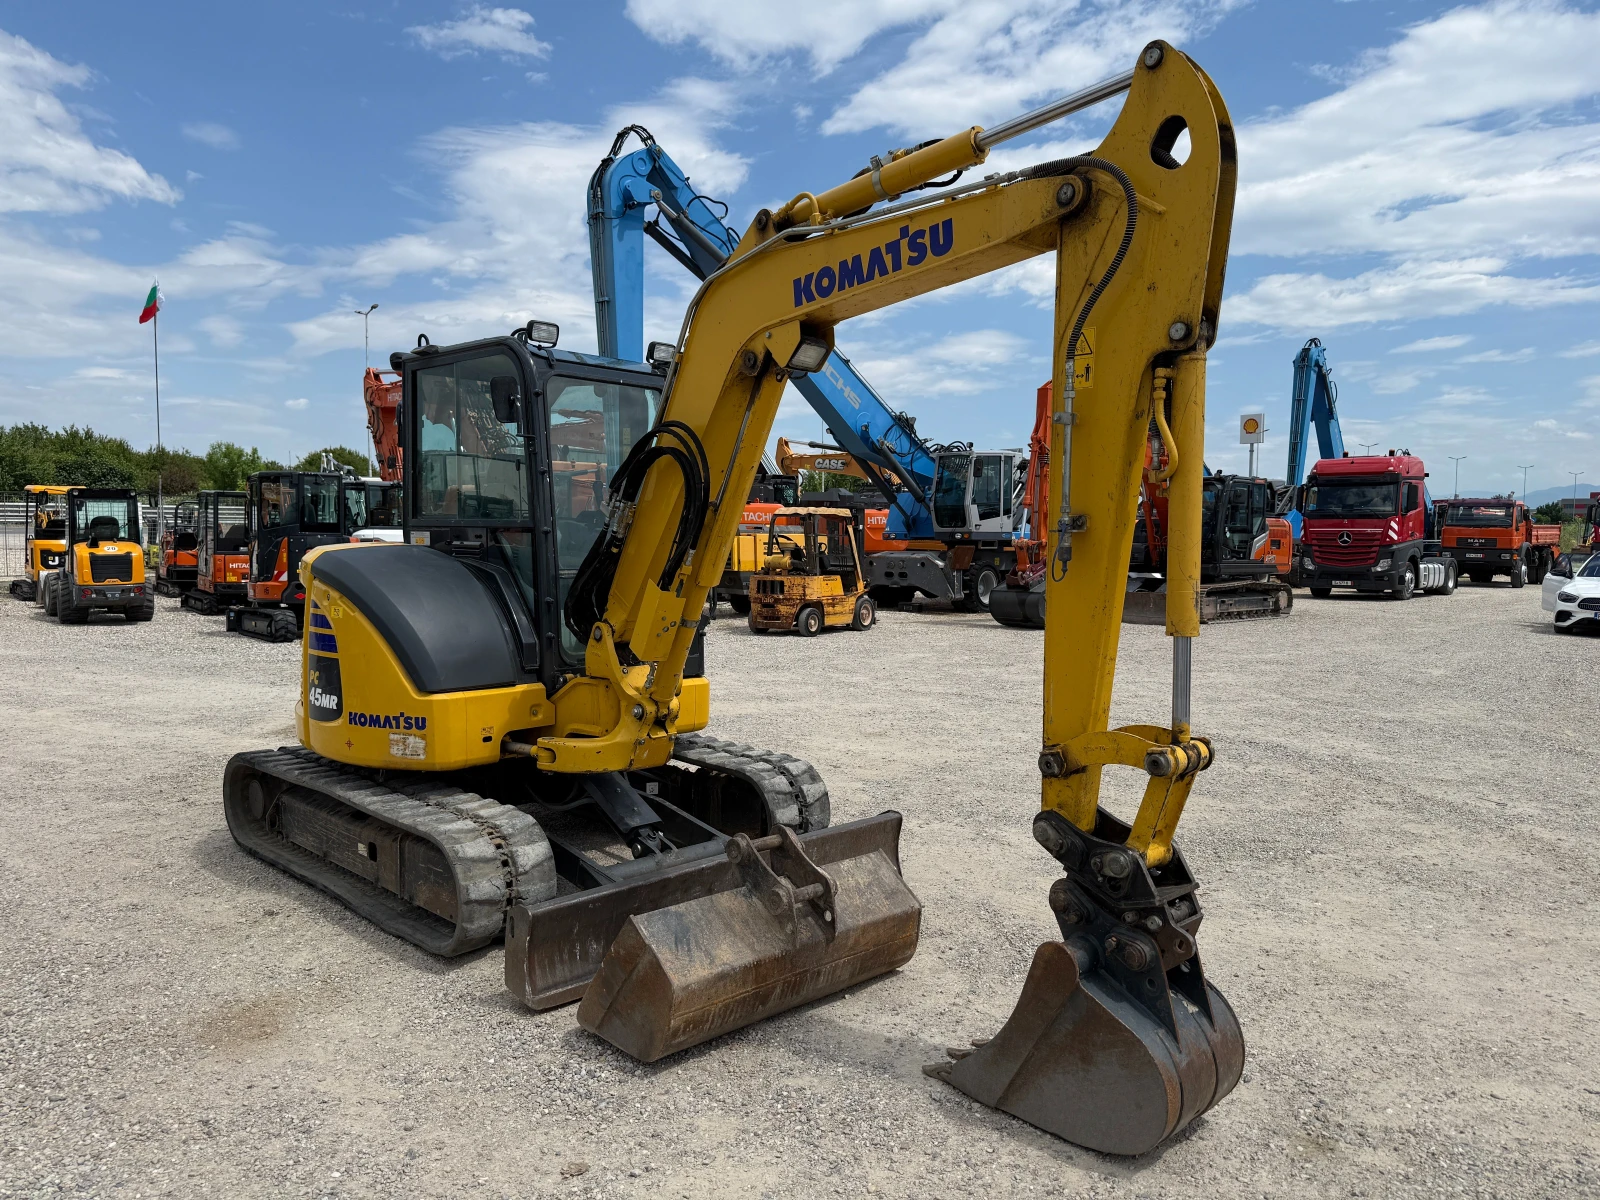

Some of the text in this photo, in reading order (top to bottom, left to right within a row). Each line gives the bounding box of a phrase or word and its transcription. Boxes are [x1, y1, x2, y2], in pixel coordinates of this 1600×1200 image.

[793, 217, 954, 308] KOMATSU
[387, 392, 403, 402] HITAC
[815, 458, 845, 470] CASE
[740, 511, 773, 522] TACHI
[867, 516, 888, 525] HITA
[309, 669, 320, 686] PC
[309, 687, 339, 710] 45MR
[348, 711, 427, 731] KOMATSU
